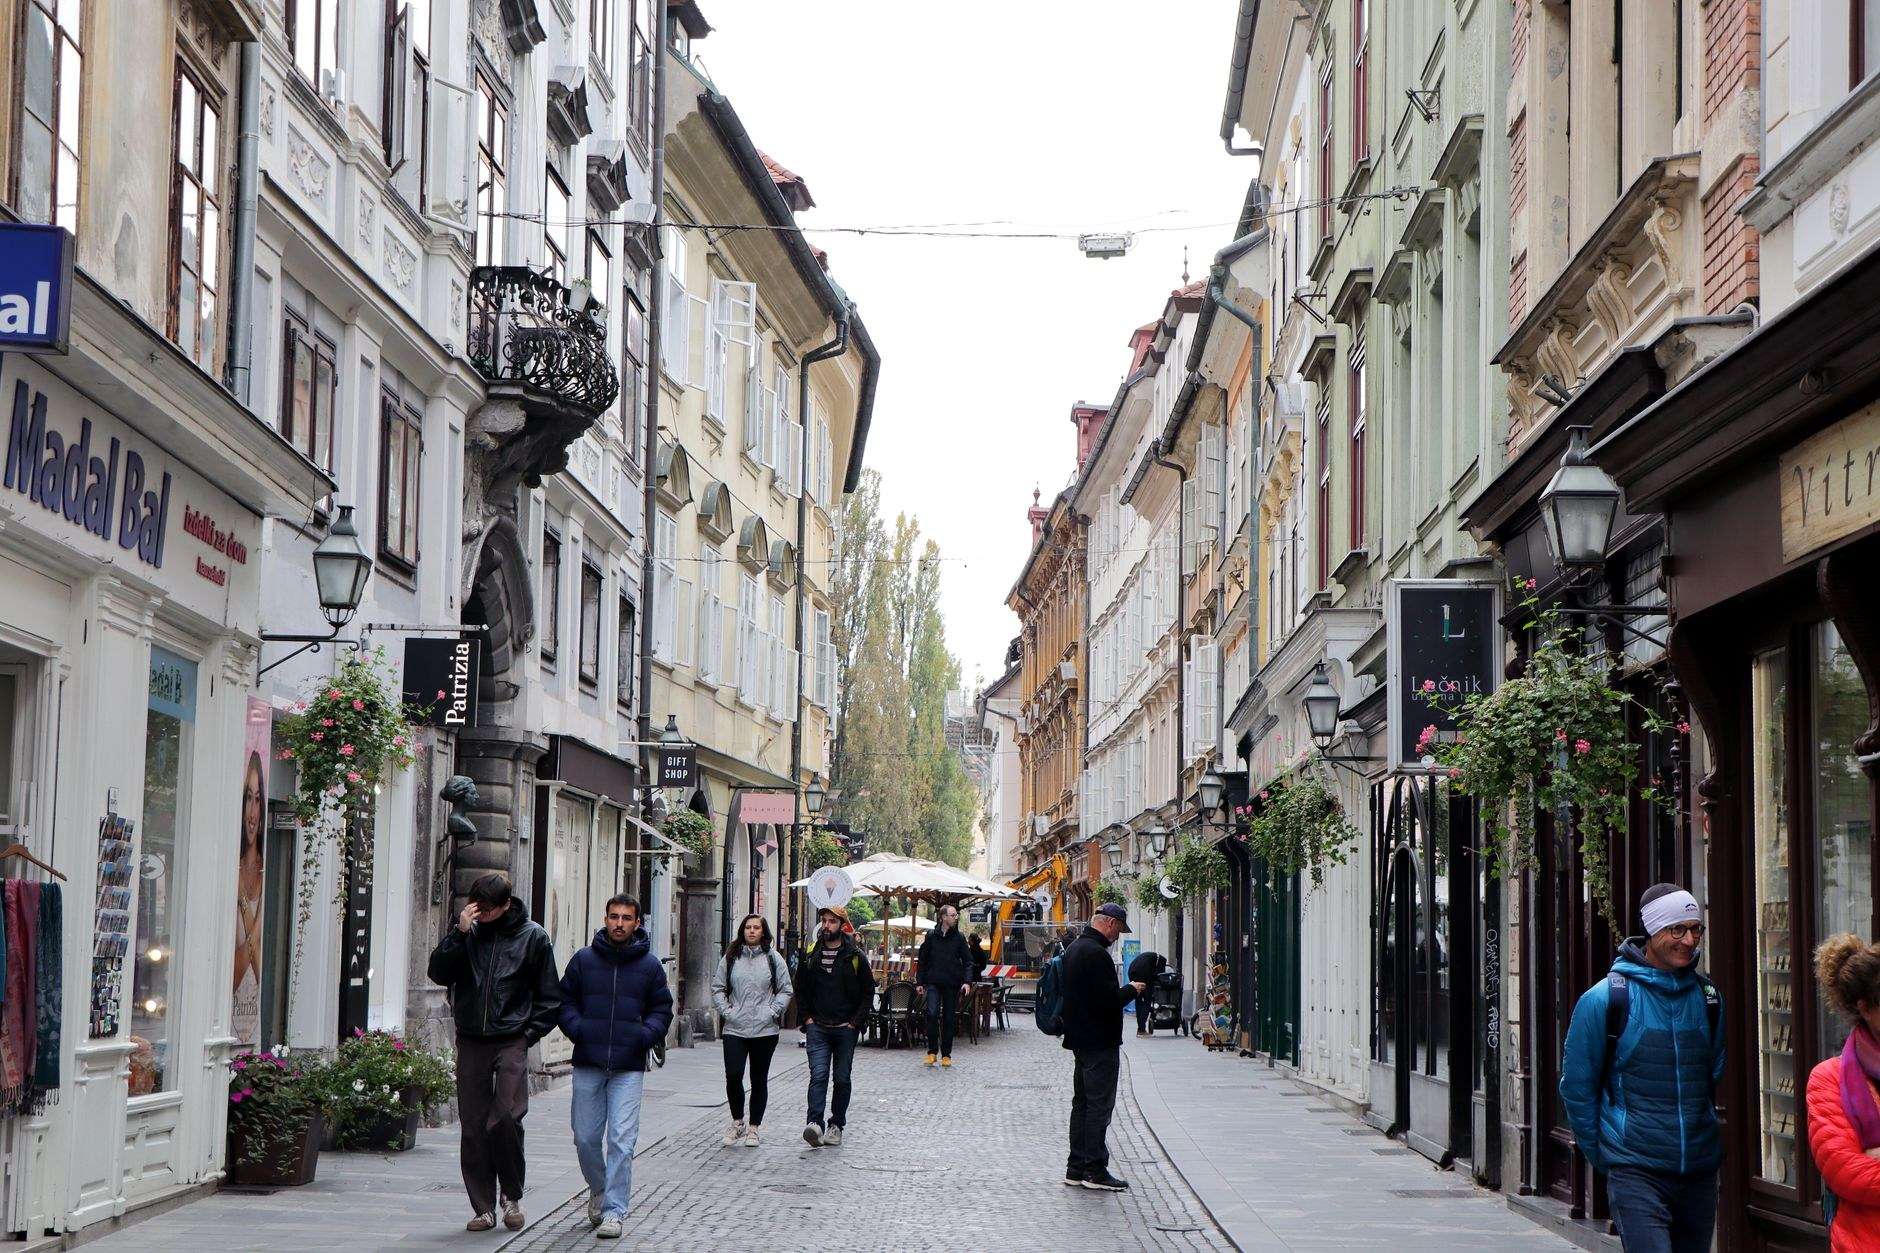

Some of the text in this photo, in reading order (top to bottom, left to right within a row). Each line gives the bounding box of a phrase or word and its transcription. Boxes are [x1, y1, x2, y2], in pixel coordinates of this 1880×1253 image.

[3, 378, 173, 569] Madal Bal
[184, 504, 248, 565] izdelki za dom
[444, 641, 470, 726] Patrizia
[1411, 674, 1483, 693] Lčnik
[665, 769, 689, 779] SHOP
[667, 756, 688, 767] GIFT
